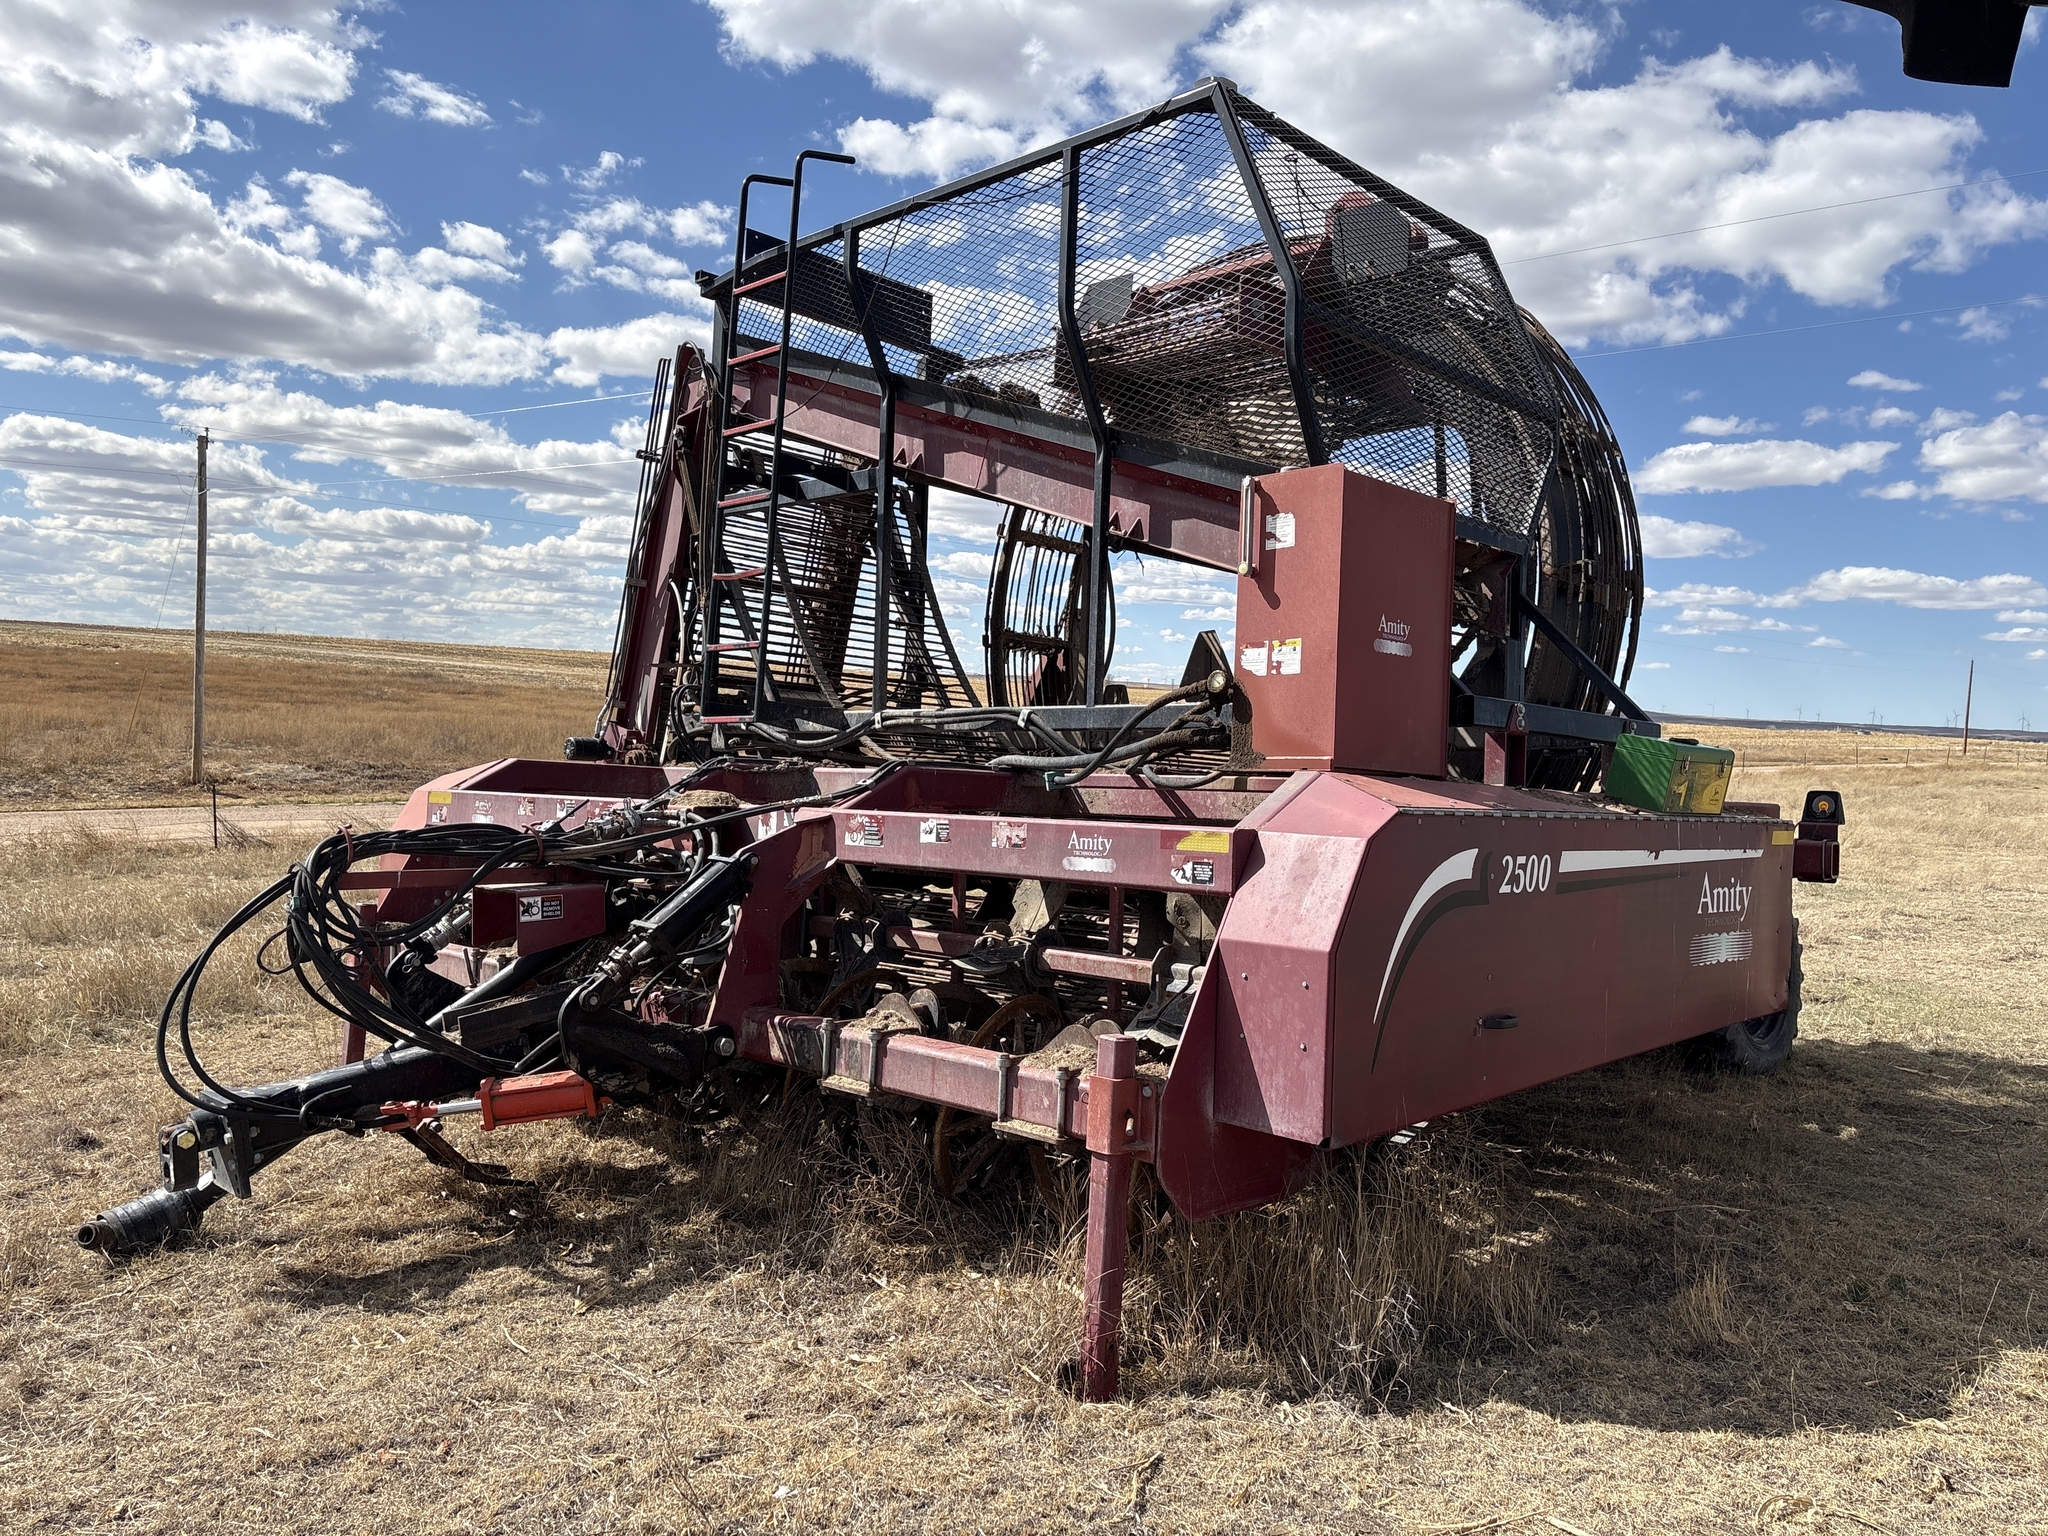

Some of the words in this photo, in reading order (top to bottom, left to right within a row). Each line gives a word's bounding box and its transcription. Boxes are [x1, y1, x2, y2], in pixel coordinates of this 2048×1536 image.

[1378, 613, 1411, 641] Amity
[1067, 829, 1113, 856] Amity
[1498, 854, 1552, 894] 2500
[1697, 871, 1752, 922] Amity
